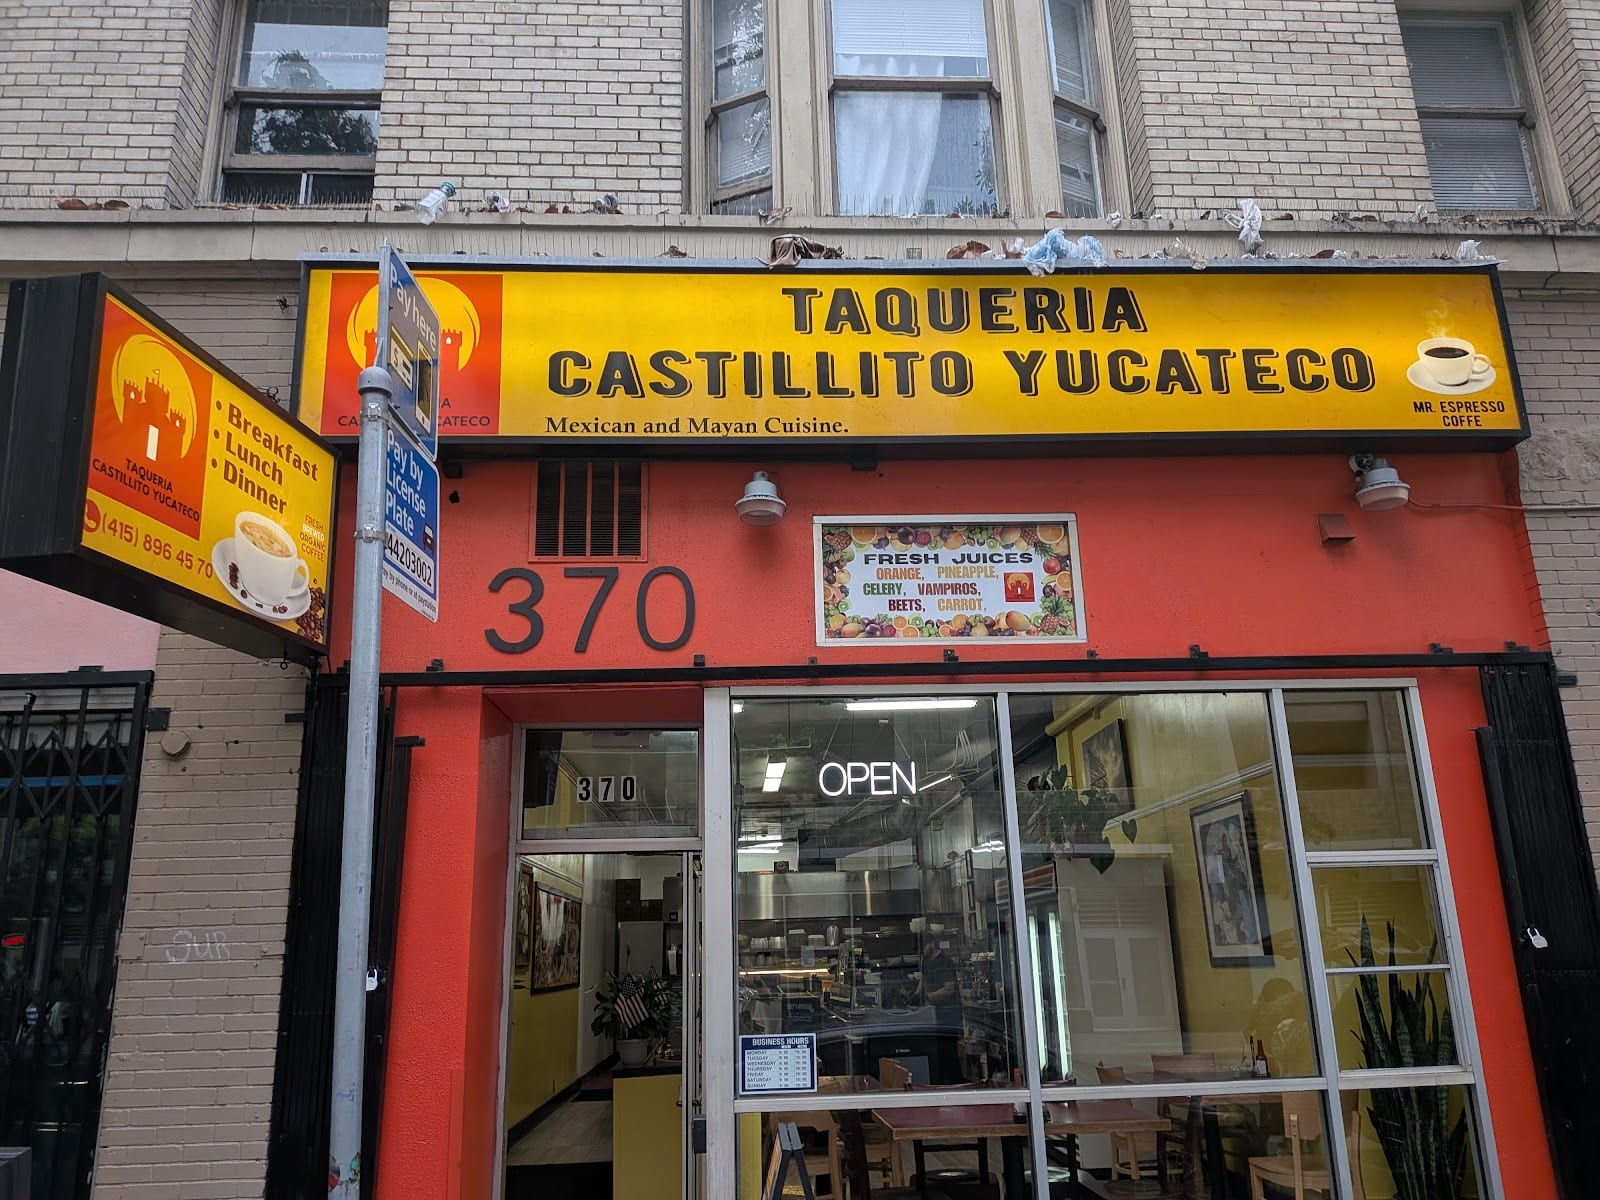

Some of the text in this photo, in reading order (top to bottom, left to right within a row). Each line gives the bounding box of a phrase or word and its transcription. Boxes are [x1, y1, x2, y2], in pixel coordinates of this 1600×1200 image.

[390, 261, 437, 352] Pay here
[781, 287, 1147, 336] TAQUERIA
[547, 347, 1376, 398] CASTILLITO YUCATECO
[1413, 400, 1505, 413] MR. ESPRESSO
[1442, 415, 1482, 427] COFFE
[227, 402, 319, 482] Breakfast
[544, 416, 849, 438] Mexican and Mayan Cuisine.
[126, 458, 174, 494] TAQUERIA
[225, 430, 283, 486] Lunch
[387, 429, 424, 492] Pay by
[92, 458, 200, 522] CASTILLITO YUCATECO
[223, 459, 287, 515] Dinner
[386, 458, 426, 518] License
[385, 488, 414, 537] Plate
[102, 512, 214, 579] (415) 896 45 70
[300, 532, 326, 551] ORGANIC
[302, 523, 325, 541] BREWED
[301, 542, 325, 562] COFFEE
[863, 552, 1033, 565] FRESH JUICES
[862, 582, 981, 597] CELERY, VAMPIROS,
[876, 565, 999, 581] ORANGE, PINEAPPLE,
[484, 565, 695, 653] 370
[888, 598, 987, 613] BEETS, CARROT,
[578, 777, 635, 801] 370
[818, 761, 917, 797] OPEN
[752, 1037, 809, 1046] BUSINESS HOURS
